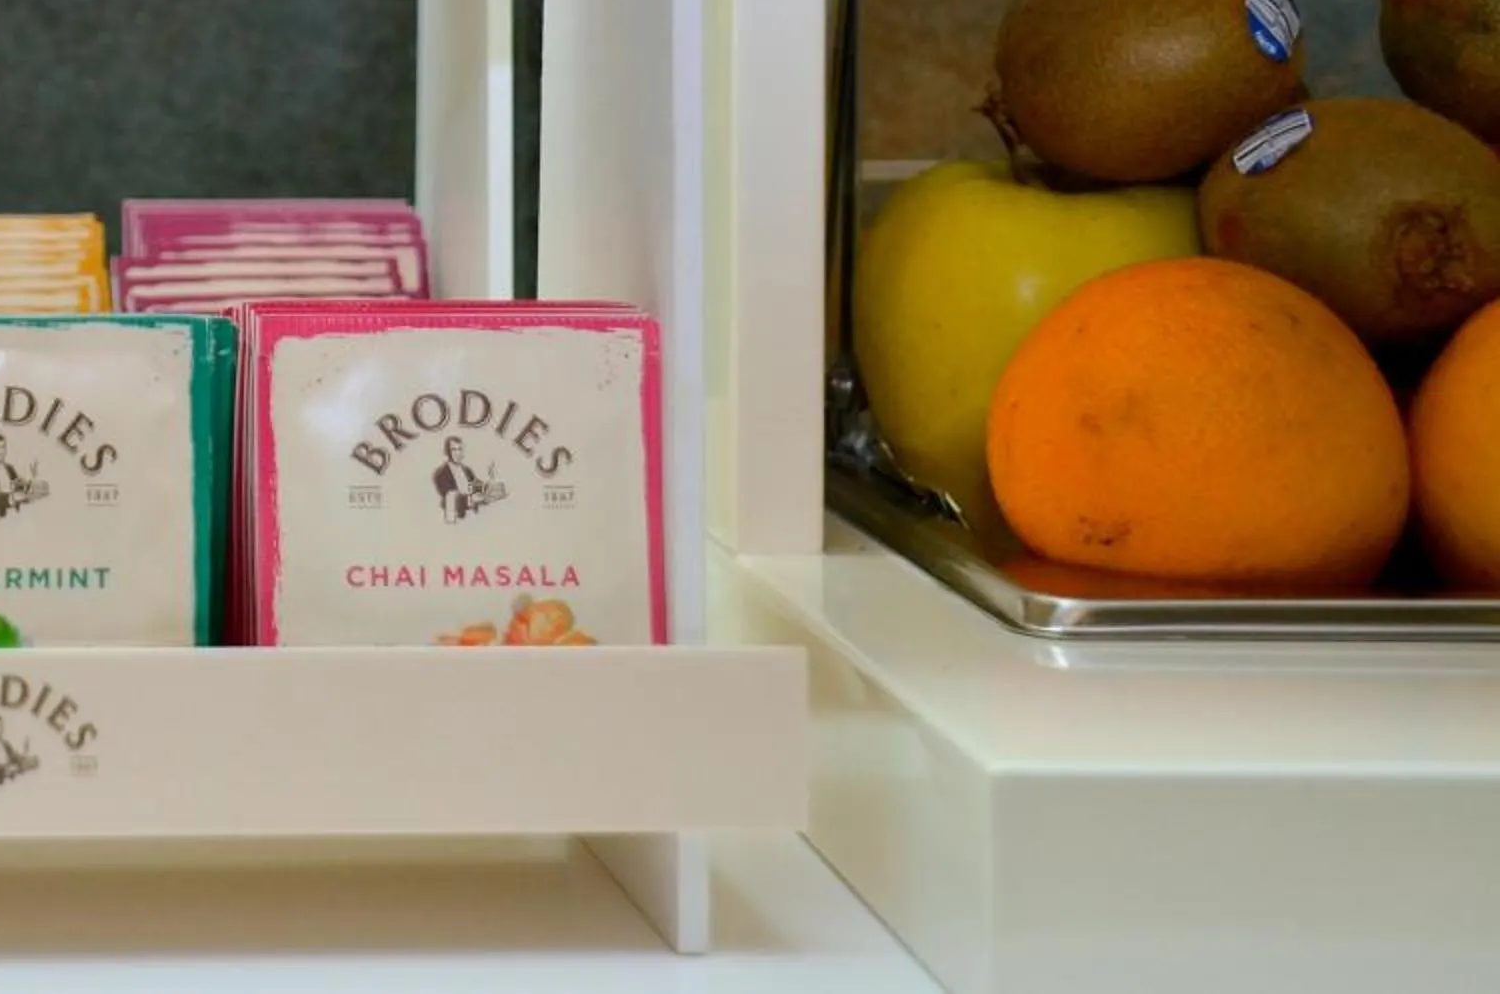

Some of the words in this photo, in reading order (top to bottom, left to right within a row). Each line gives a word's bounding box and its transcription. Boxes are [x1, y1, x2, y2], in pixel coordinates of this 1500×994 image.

[350, 389, 574, 480] BRODIES
[346, 565, 427, 587] CHAI
[443, 565, 581, 587] MASALA
